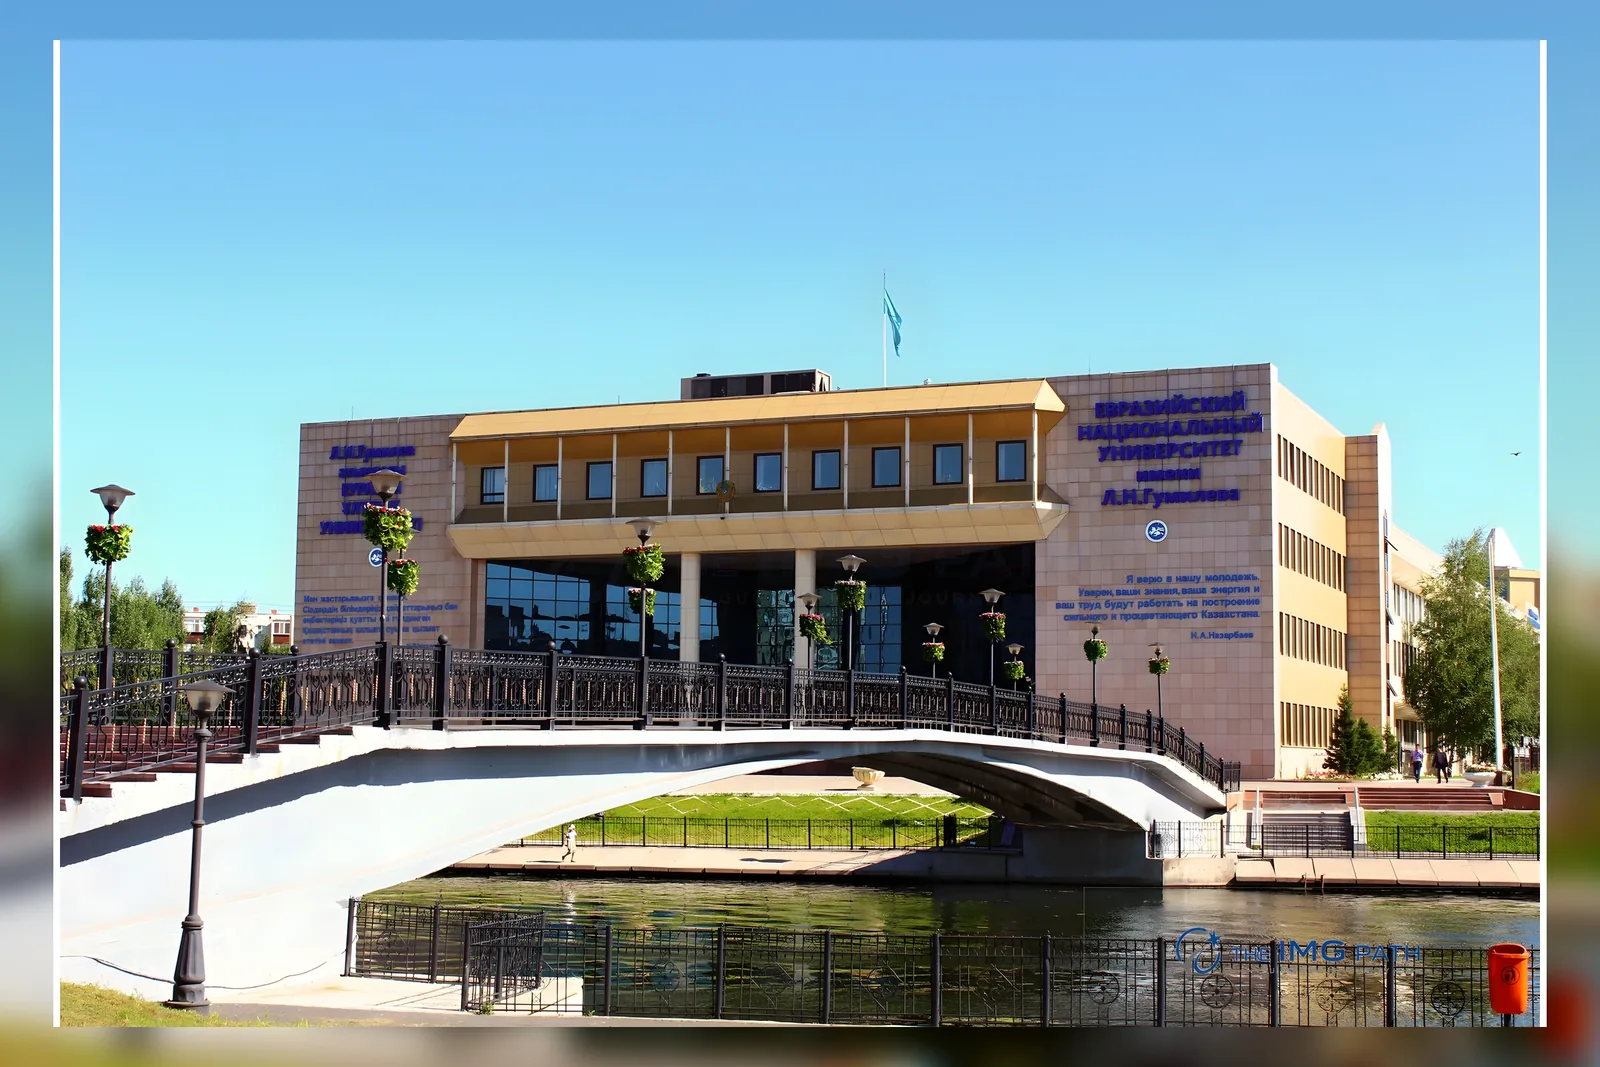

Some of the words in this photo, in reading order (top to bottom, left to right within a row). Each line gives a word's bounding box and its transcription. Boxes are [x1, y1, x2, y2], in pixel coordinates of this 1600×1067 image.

[1095, 390, 1246, 418] ЕВРАЗИЙСКИЙ
[1078, 412, 1264, 443] НАЦИОНАЛЬНЫЙ
[1098, 440, 1243, 462] УНИВЕРСИТЕТ
[1136, 468, 1201, 482] имени
[1101, 488, 1240, 509] Л.Н.Гумилева
[1126, 575, 1133, 583] Я
[1136, 576, 1163, 584] верю
[1176, 575, 1201, 583] нашу
[1079, 602, 1102, 610] труд
[1105, 600, 1134, 610] будут
[1138, 599, 1183, 609] работать
[1202, 598, 1260, 608] построение
[1202, 610, 1260, 618] Казахстана.
